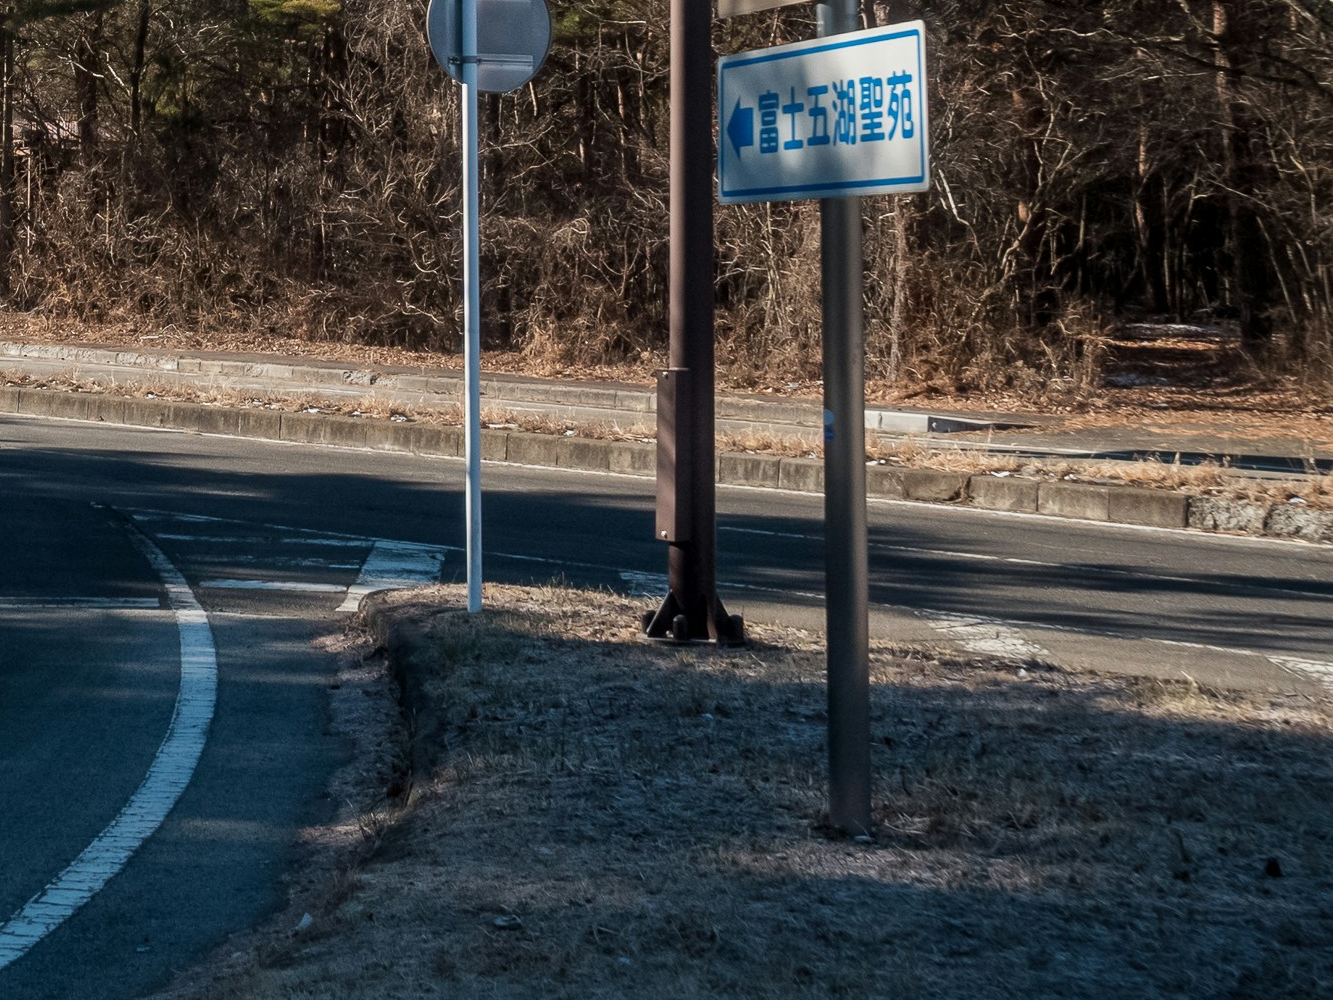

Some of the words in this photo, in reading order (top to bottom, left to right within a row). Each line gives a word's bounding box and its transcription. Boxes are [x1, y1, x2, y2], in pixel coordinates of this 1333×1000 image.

[758, 69, 914, 154] 富士五湖聖苑
